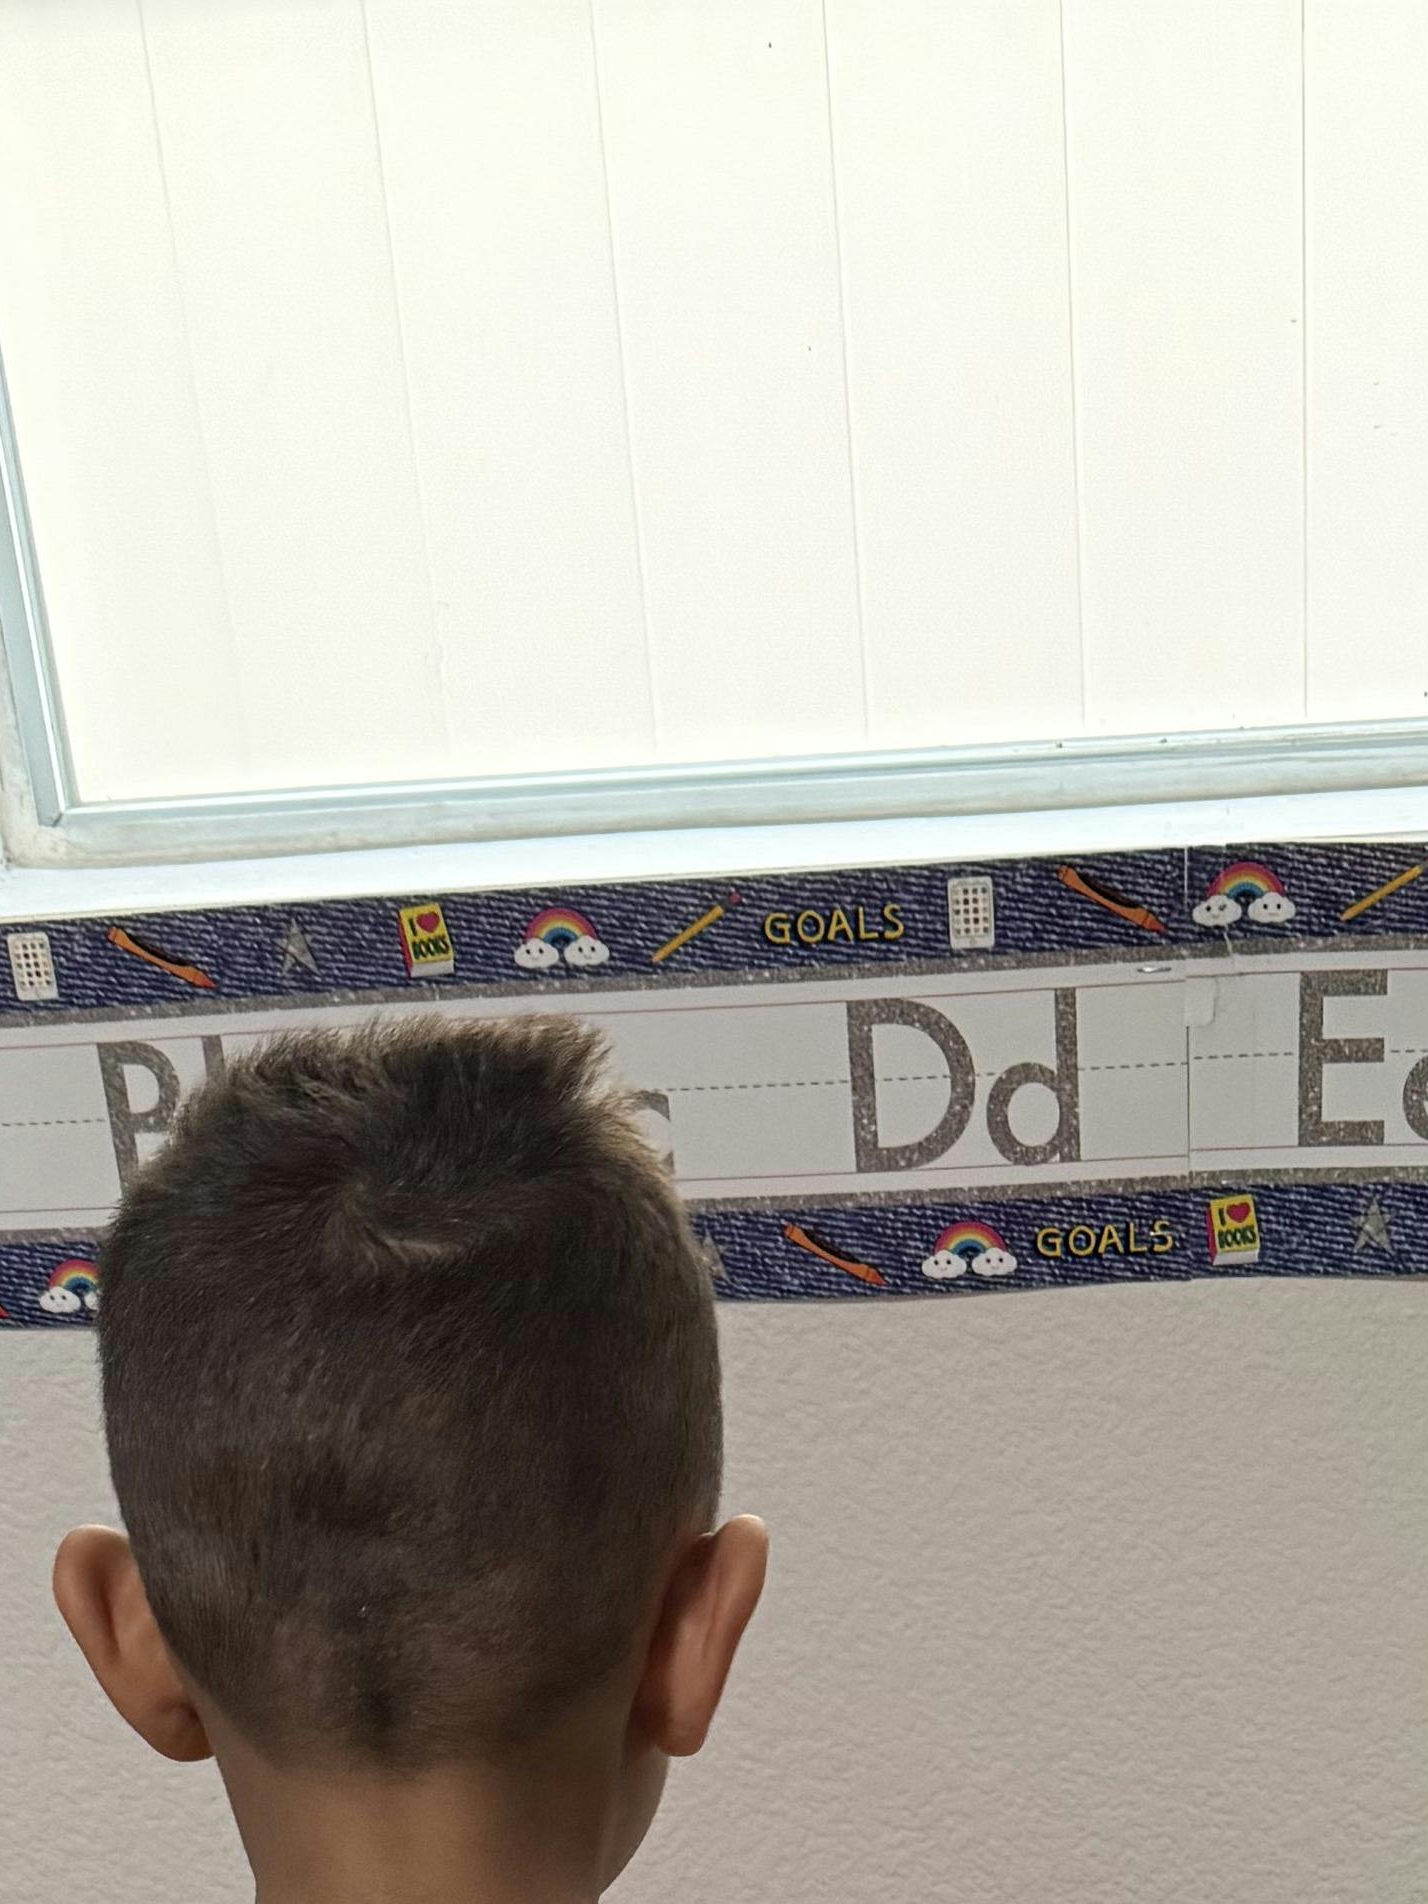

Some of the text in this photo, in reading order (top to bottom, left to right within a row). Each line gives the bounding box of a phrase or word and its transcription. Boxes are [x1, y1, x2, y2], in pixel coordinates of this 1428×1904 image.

[763, 902, 906, 944] GOALS
[846, 987, 1081, 1172] Dd
[1034, 1219, 1175, 1257] GOALS
